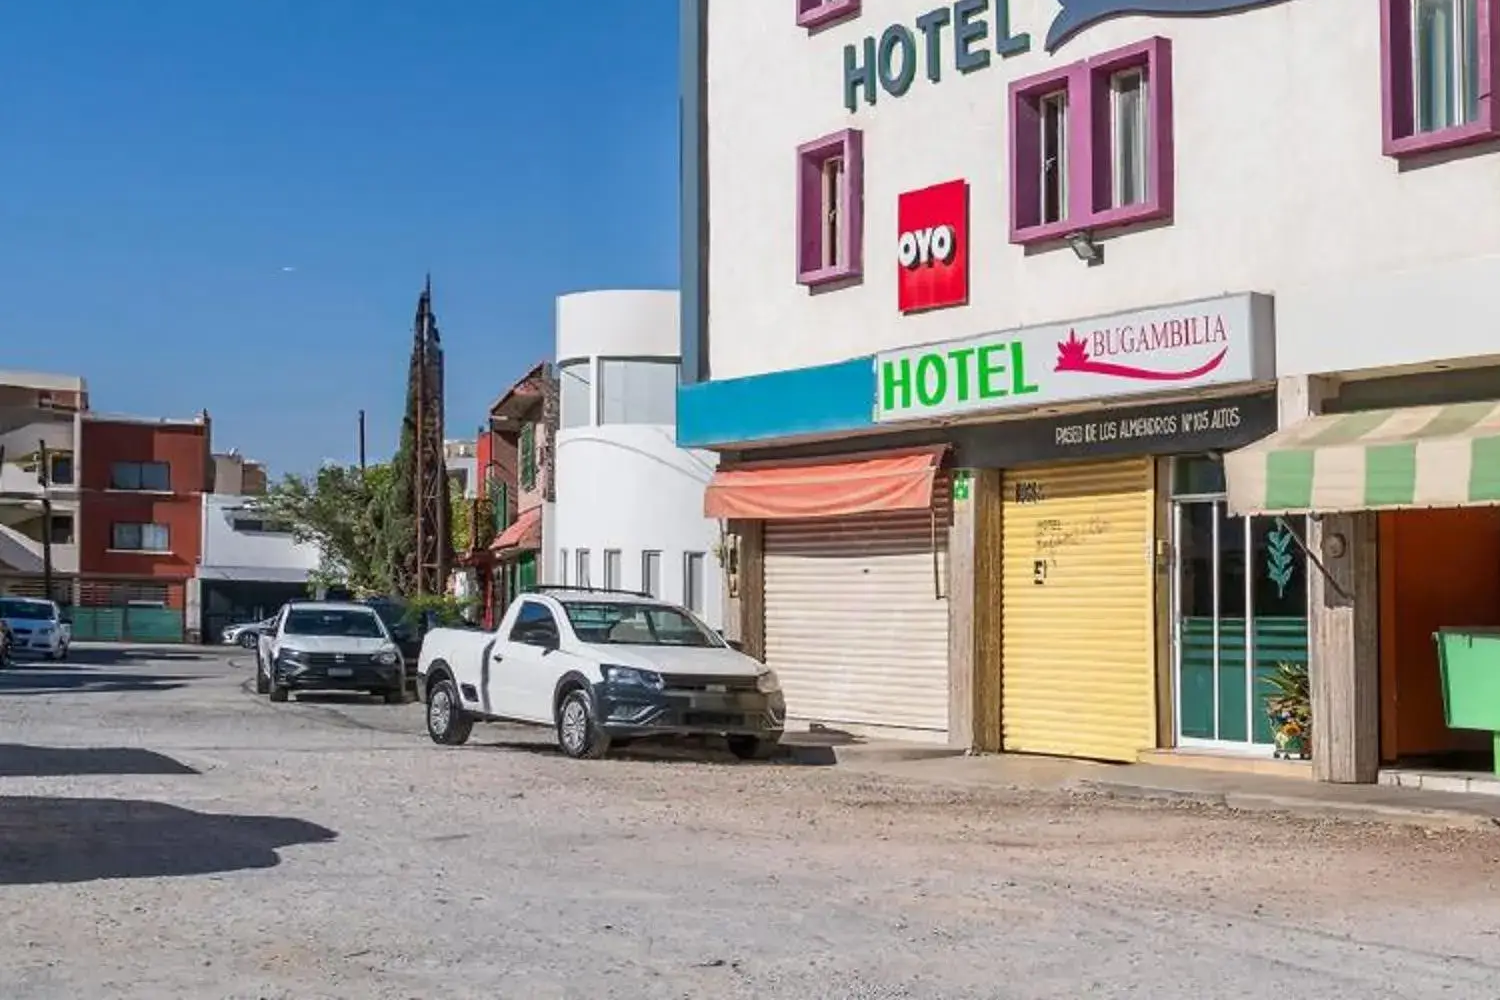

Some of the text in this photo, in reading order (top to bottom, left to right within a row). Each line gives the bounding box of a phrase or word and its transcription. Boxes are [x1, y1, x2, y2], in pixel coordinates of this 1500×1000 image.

[898, 224, 953, 268] OYO
[882, 314, 1228, 411] HOTEL BUGAMBILIA
[1055, 425, 1083, 446] PASEO
[1085, 423, 1098, 443] DE
[1100, 421, 1117, 441] LOS
[1119, 414, 1178, 439] ALMENDROS
[1211, 406, 1241, 429] ALTOS
